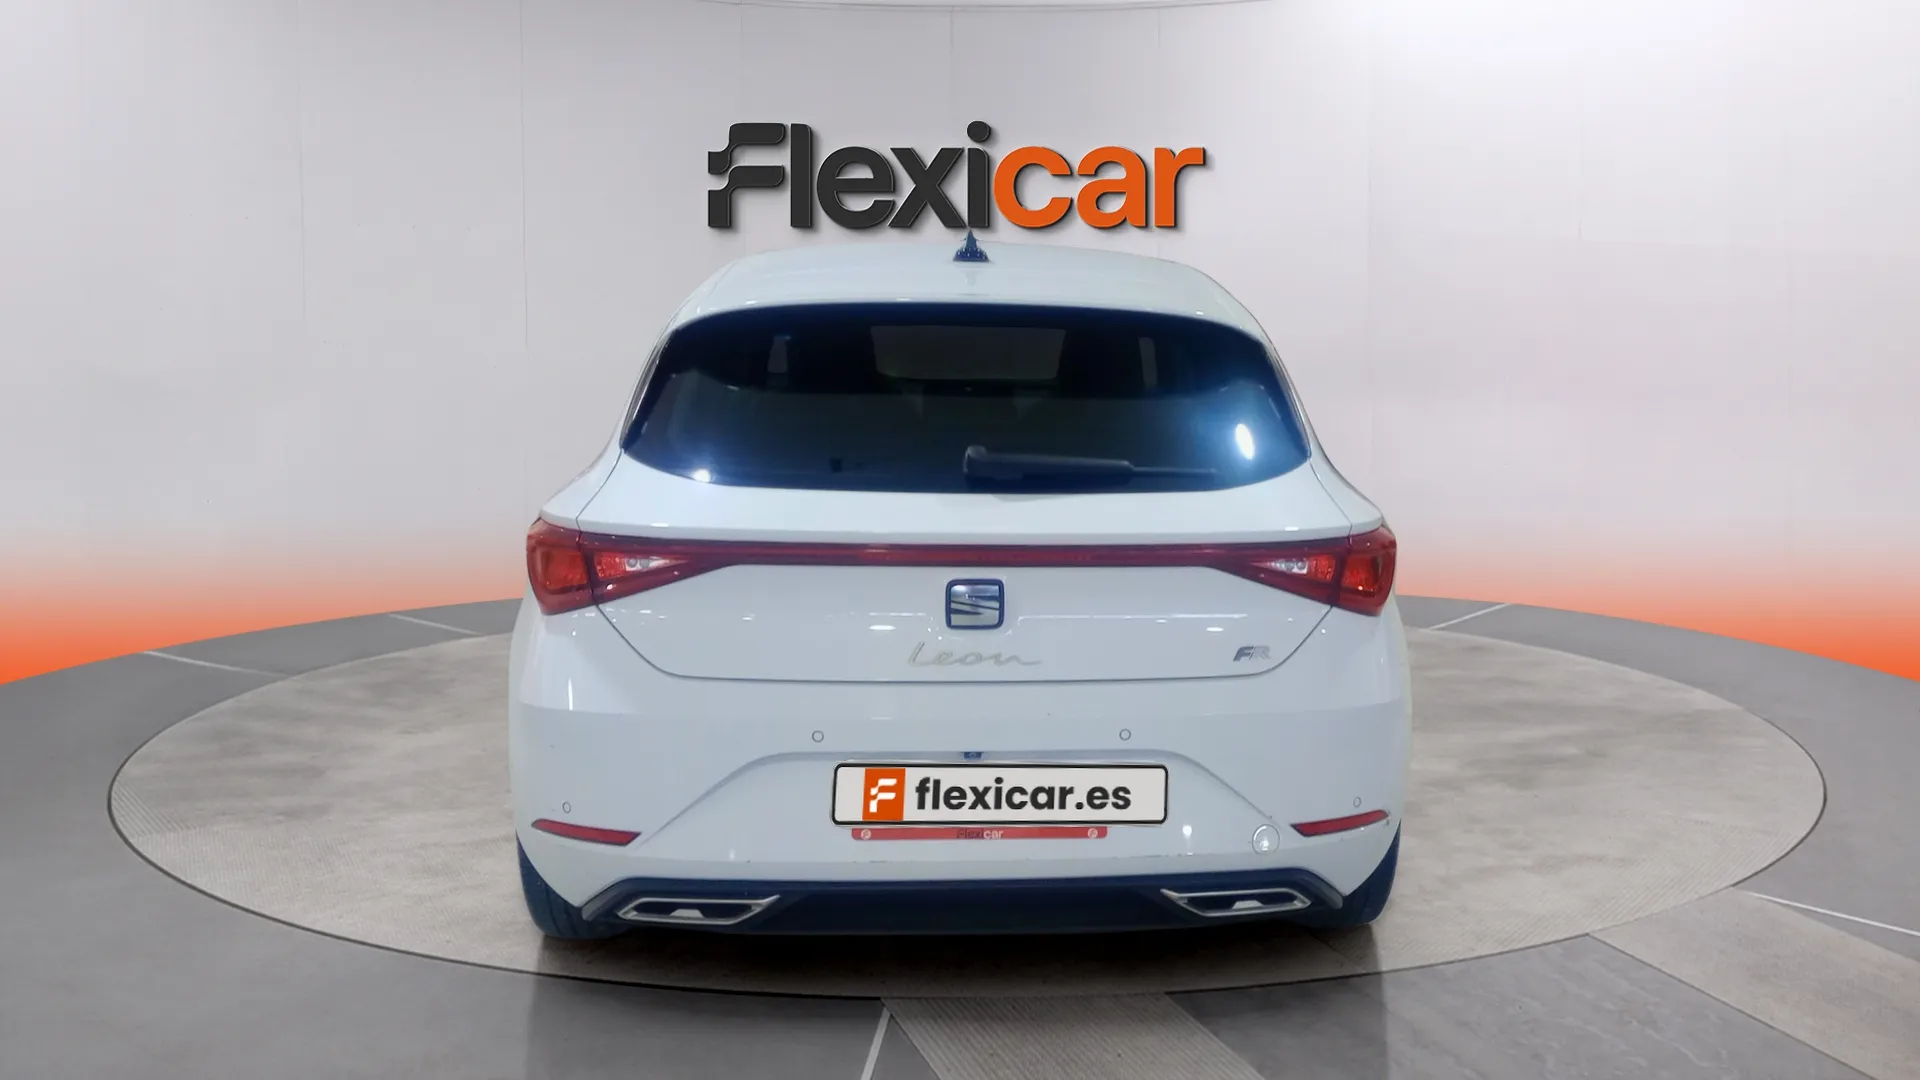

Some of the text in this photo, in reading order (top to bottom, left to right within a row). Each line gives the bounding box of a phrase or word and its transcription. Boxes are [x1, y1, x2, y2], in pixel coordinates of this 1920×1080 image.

[707, 120, 1206, 229] Flexicar
[1232, 645, 1271, 663] FR
[915, 776, 1132, 811] flexicar.es
